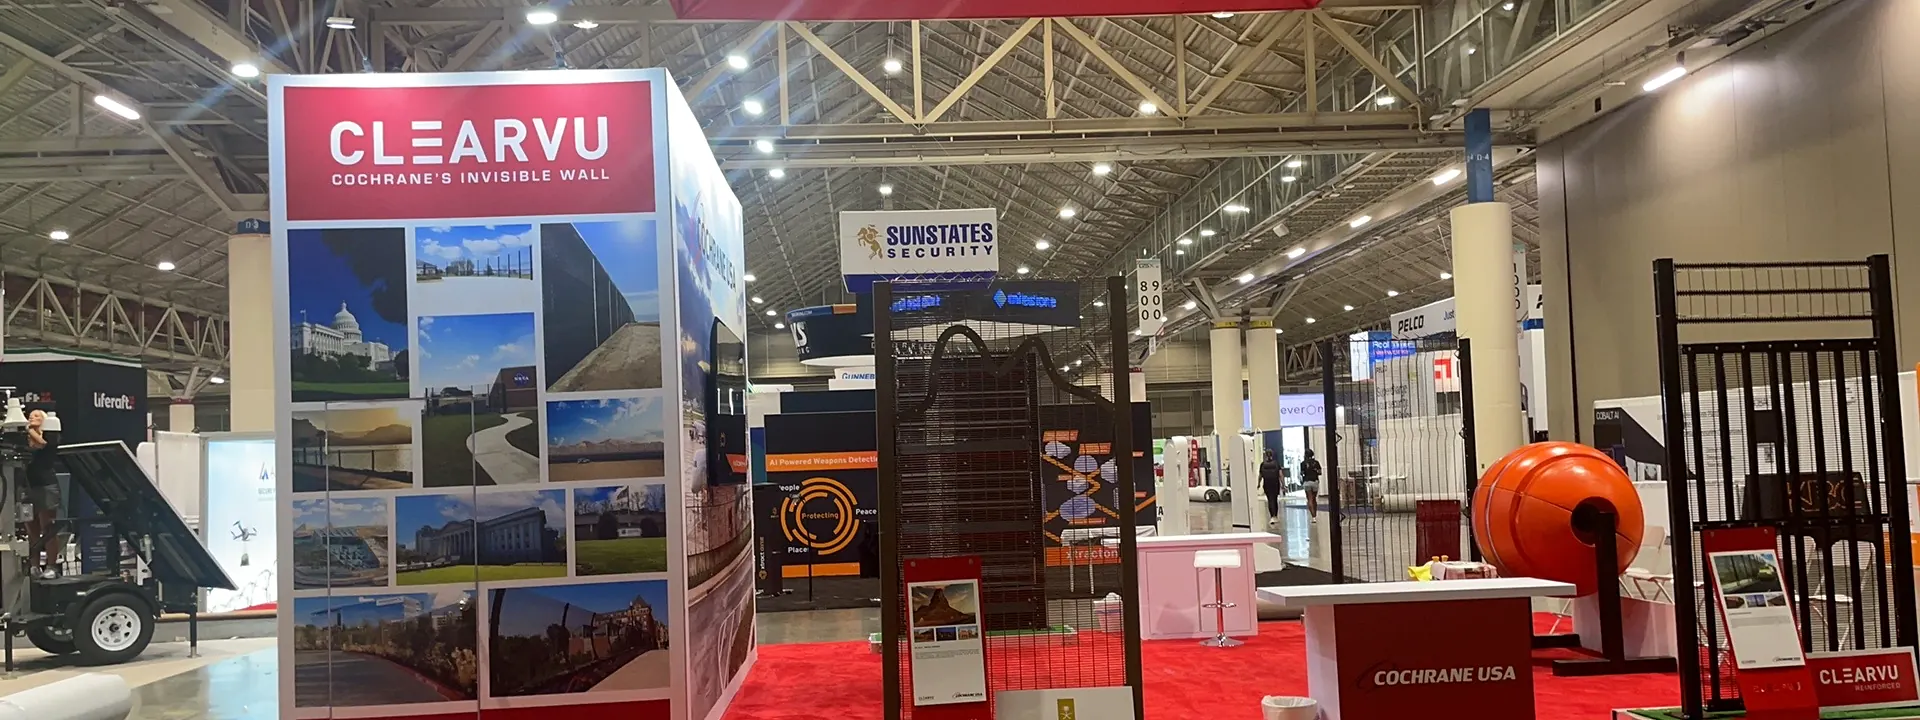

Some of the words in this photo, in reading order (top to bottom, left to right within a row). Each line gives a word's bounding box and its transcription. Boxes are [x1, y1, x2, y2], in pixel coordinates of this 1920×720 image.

[330, 116, 609, 165] CLEARVU
[331, 172, 452, 186] COCHRANE'S
[460, 170, 551, 184] INVISIBLE
[560, 168, 610, 181] WALL
[886, 222, 994, 247] SUNSTATES
[887, 245, 994, 259] SECURITY
[1397, 315, 1425, 335] PELCO
[780, 458, 812, 466] Powered
[813, 457, 847, 467] Weapons
[848, 456, 878, 464] Detecti
[779, 484, 800, 492] eople
[1374, 667, 1474, 686] COCHRANE
[1477, 665, 1517, 682] USA
[1819, 664, 1899, 685] CLEARVU
[1854, 682, 1901, 692] REINFORCED
